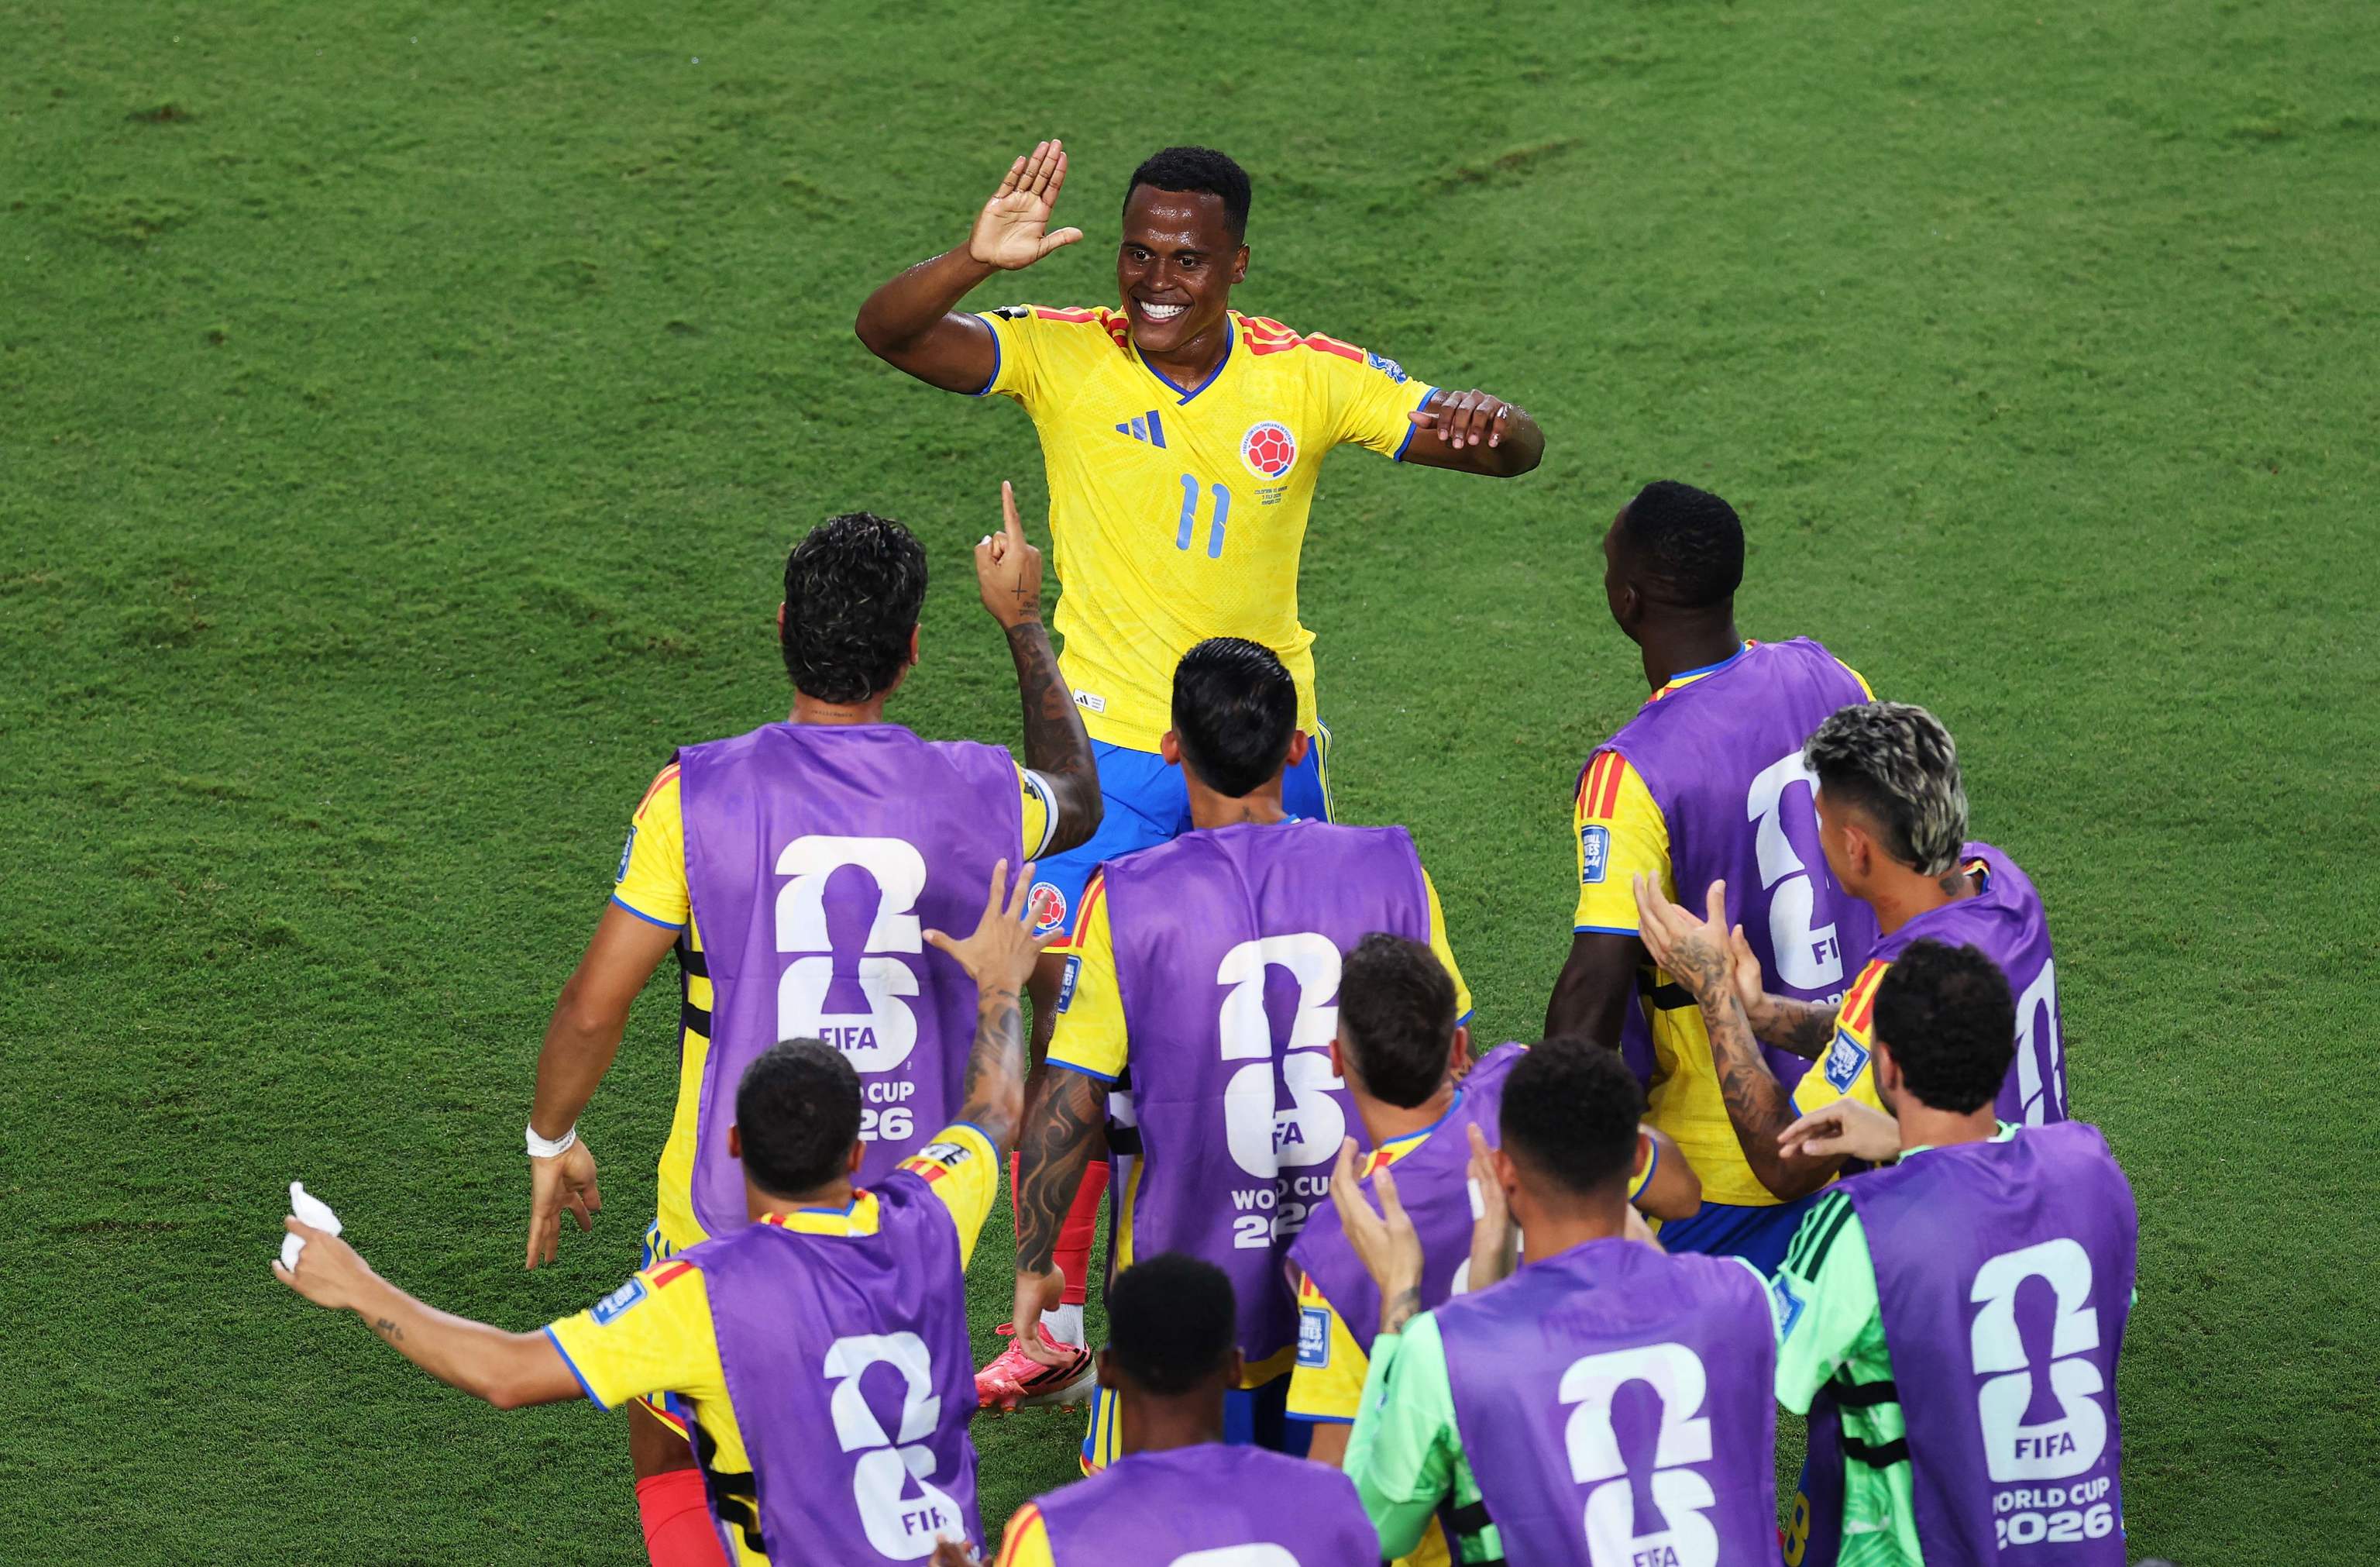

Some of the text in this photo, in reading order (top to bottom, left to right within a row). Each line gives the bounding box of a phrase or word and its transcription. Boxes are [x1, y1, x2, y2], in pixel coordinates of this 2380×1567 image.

[1176, 473, 1230, 559] 11
[1811, 937, 1838, 965] FI
[867, 1081, 916, 1104] CUP
[860, 1107, 914, 1142] 26
[1293, 1176, 1333, 1196] CU
[2014, 1432, 2076, 1461] FIFA
[1993, 1476, 2110, 1516] ORLD CUP
